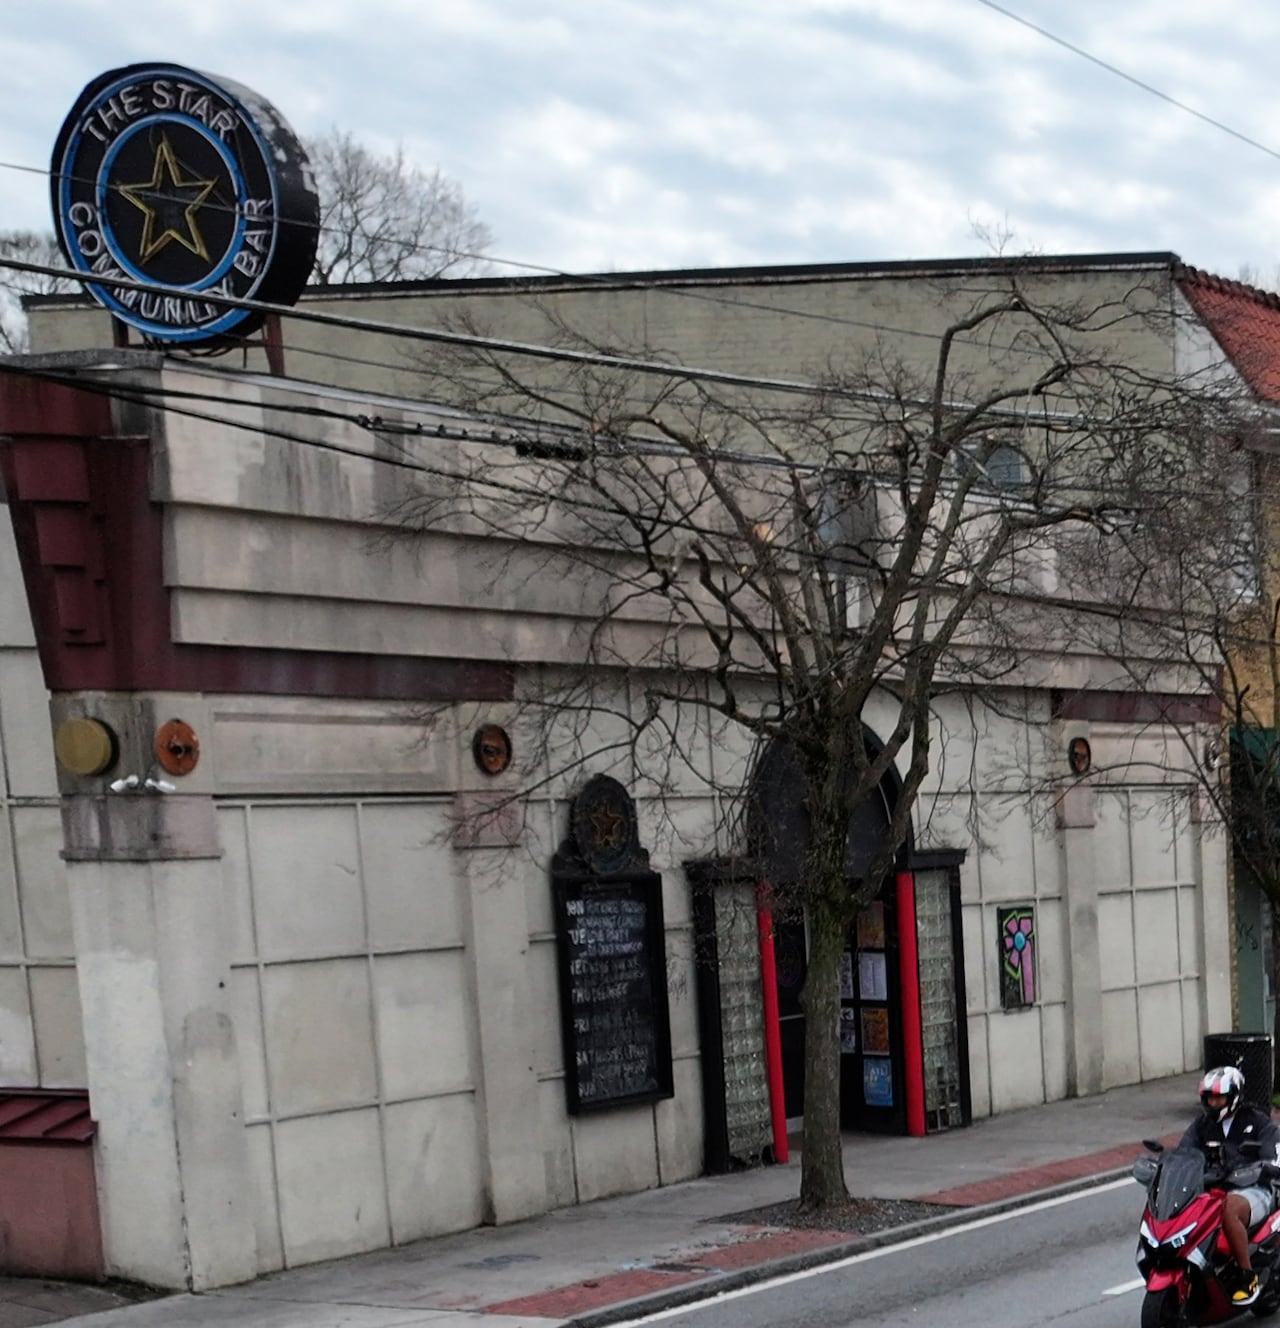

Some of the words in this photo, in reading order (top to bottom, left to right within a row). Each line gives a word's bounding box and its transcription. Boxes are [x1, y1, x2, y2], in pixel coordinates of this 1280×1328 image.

[81, 85, 144, 142] THE
[151, 79, 240, 140] STAR
[232, 198, 274, 278] BAR
